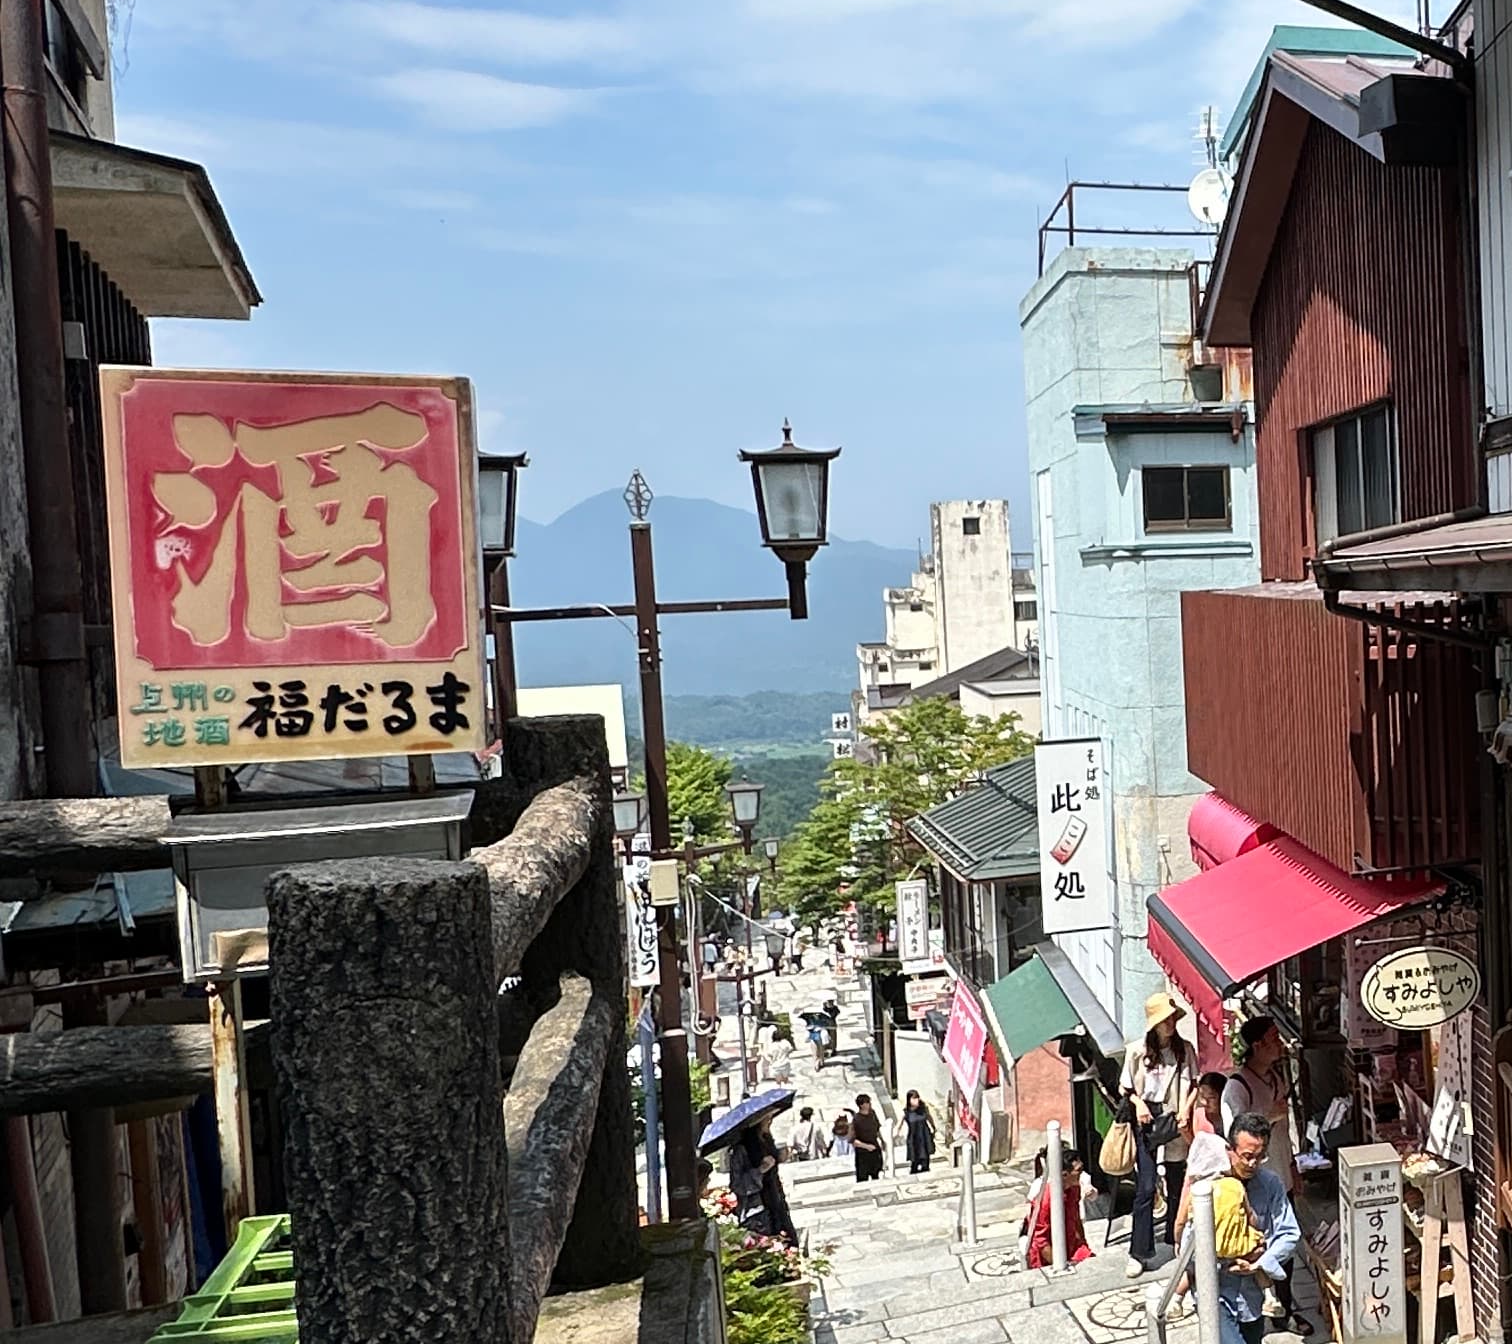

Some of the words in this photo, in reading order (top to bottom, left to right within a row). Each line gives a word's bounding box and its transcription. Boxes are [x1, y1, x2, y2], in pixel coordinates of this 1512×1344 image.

[150, 401, 437, 647] 酒
[142, 716, 231, 747] 地酒
[238, 671, 472, 739] 福だるま
[1084, 748, 1101, 801] そば処
[1382, 975, 1473, 1004] すみよしや
[1355, 1182, 1397, 1197] おみやげ
[1366, 1208, 1391, 1324] すみよしや
